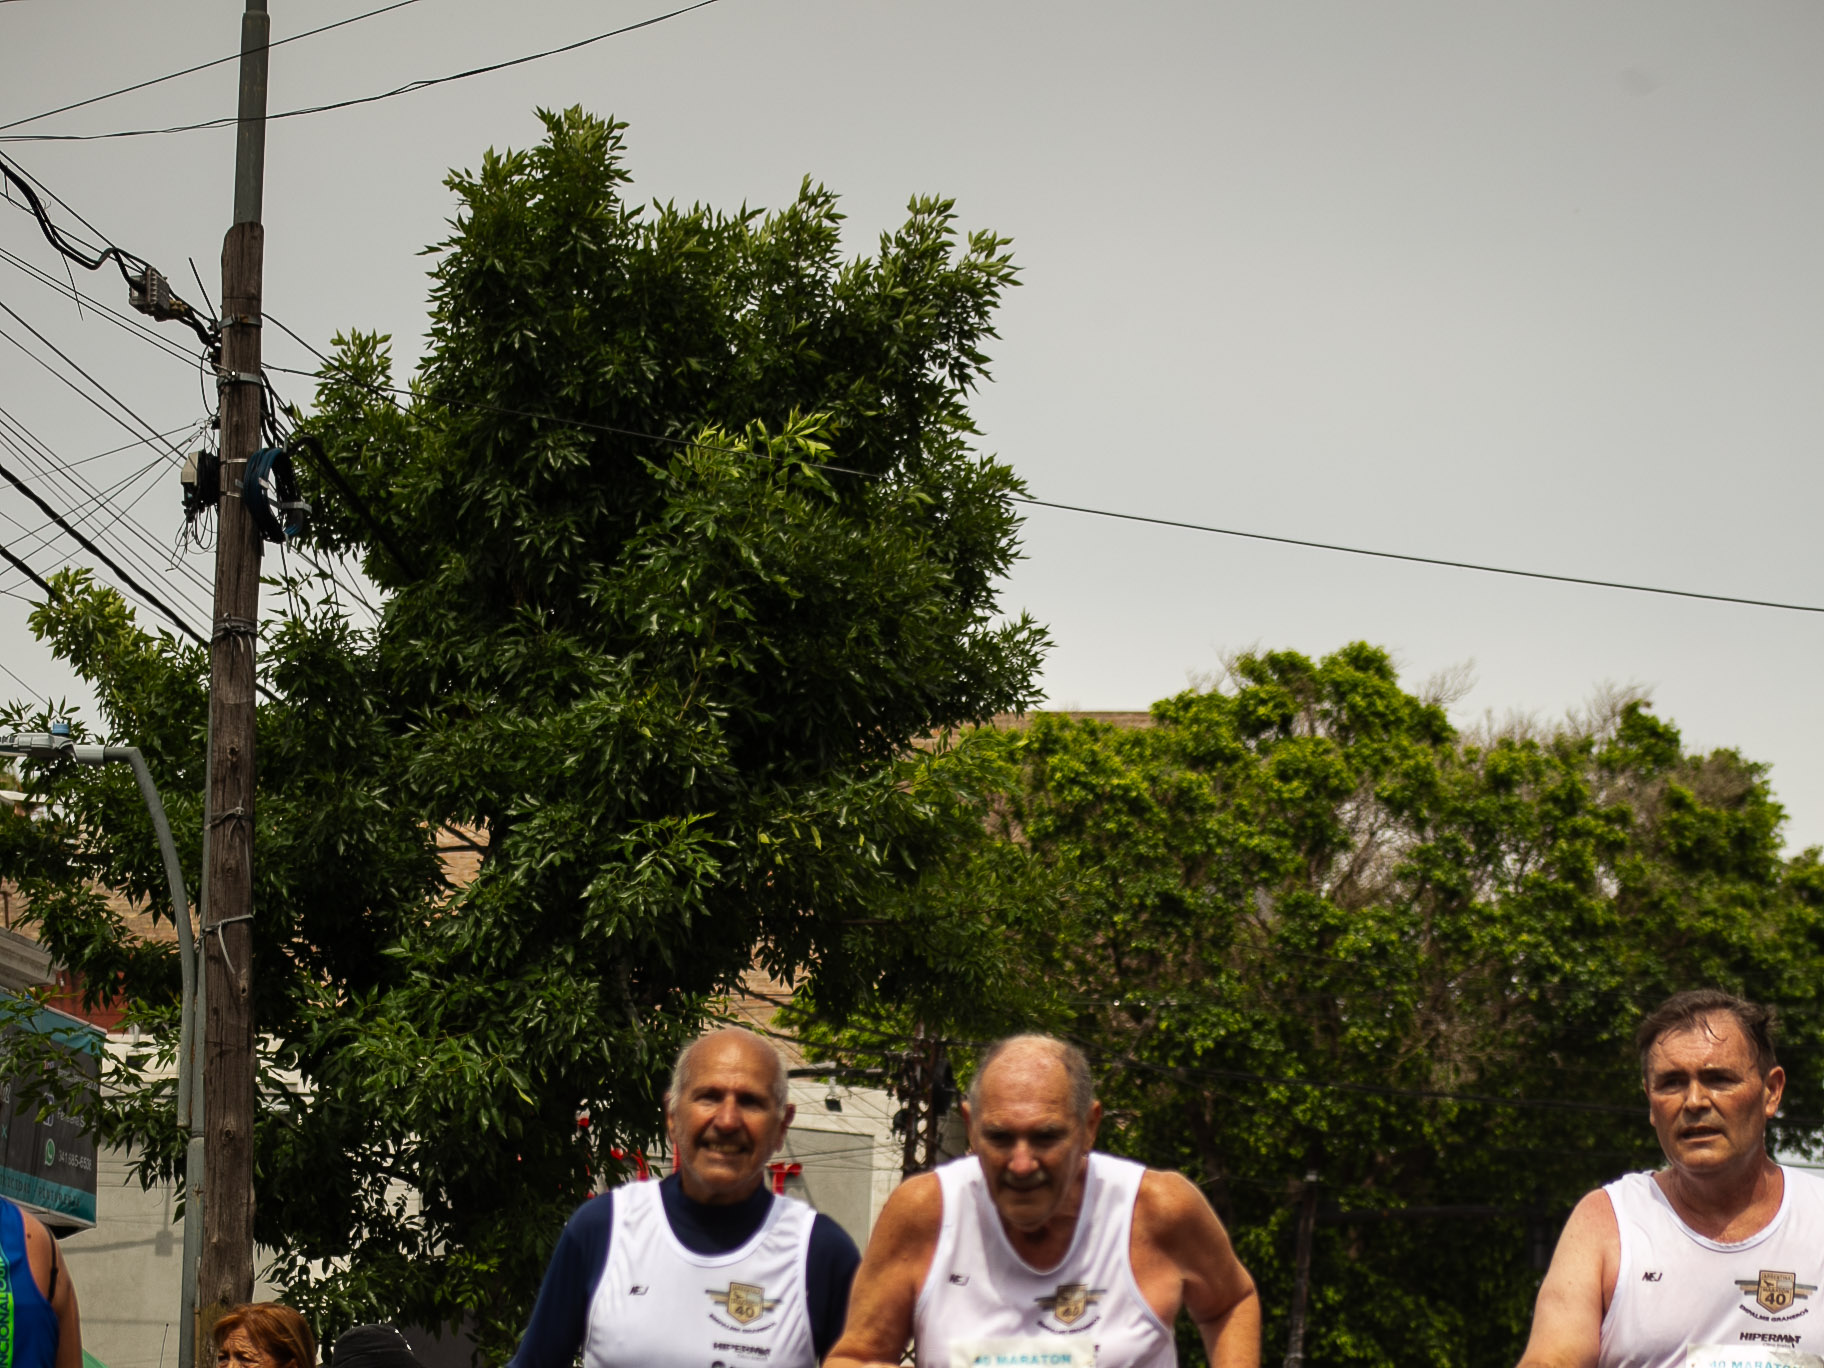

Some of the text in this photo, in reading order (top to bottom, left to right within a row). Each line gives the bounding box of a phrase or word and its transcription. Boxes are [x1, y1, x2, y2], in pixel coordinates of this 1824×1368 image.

[1765, 1293, 1786, 1305] 40
[735, 1306, 755, 1318] 40
[1739, 1304, 1808, 1322] EMPALME GRANEROS
[996, 1354, 1072, 1365] MARATON
[1710, 1361, 1726, 1368] 40
